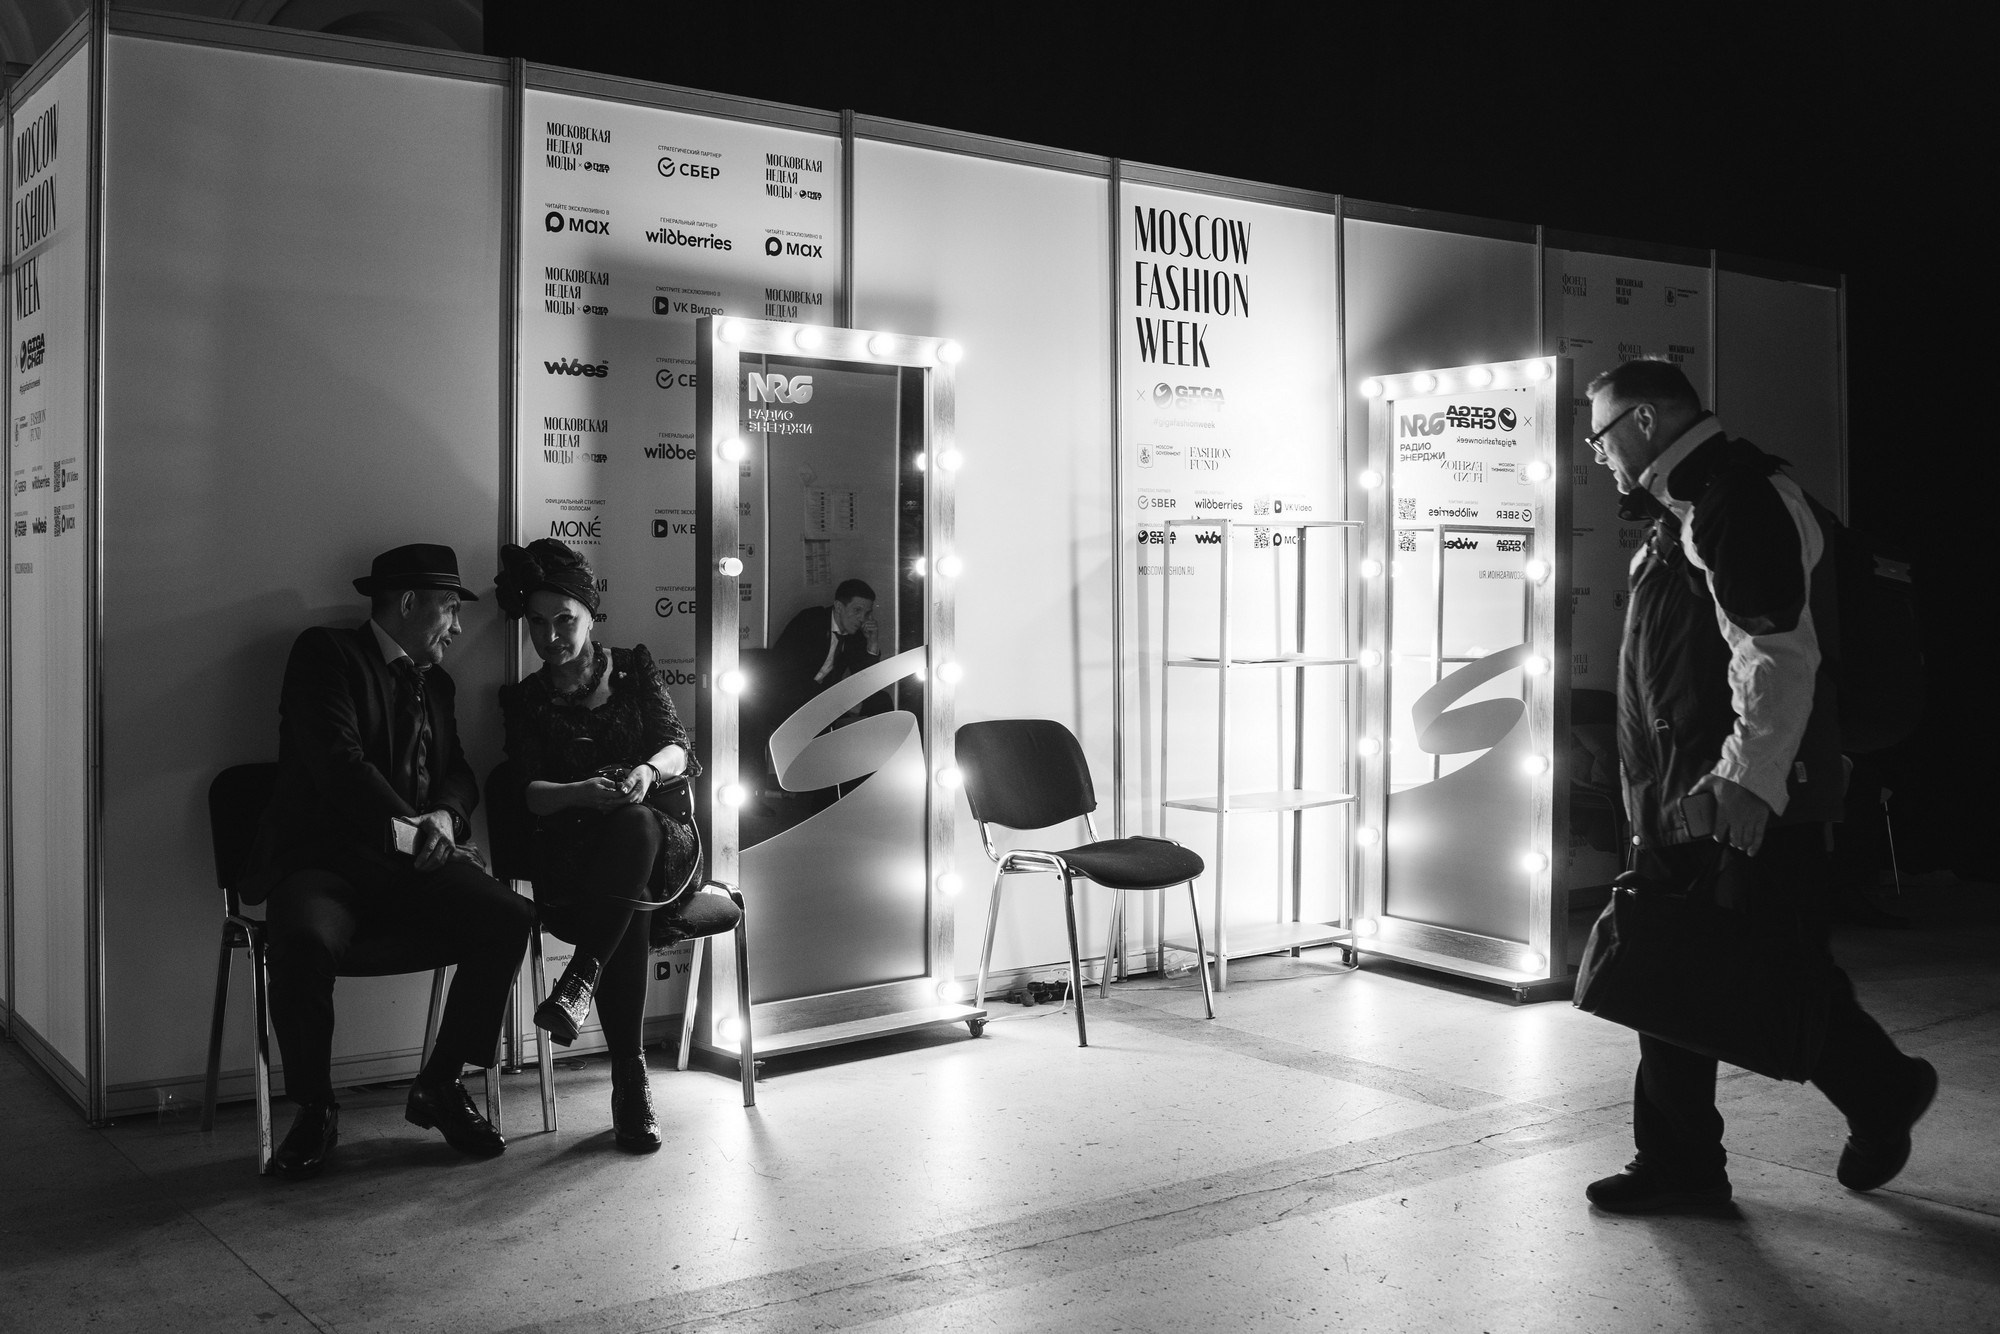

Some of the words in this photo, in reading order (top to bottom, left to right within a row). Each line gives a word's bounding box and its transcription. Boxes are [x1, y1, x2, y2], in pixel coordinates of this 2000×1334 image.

[547, 122, 610, 143] МОСКОВСКАЯ
[16, 99, 59, 190] MOSCOW
[547, 139, 582, 155] НЕДЕЛЯ
[658, 145, 699, 156] СТРАТЕГИЧЕСКИЙ
[546, 154, 576, 171] МОДЫ
[766, 153, 822, 172] МОСКОВСКАЯ
[680, 163, 720, 179] СБЕР
[766, 169, 798, 184] НЕДЕЛЯ
[766, 184, 792, 199] МОДЫ
[16, 172, 57, 256] FASHION
[568, 206, 605, 214] ЭКСКЛЮЗИВНО
[660, 217, 695, 226] ГЕНЕРАЛЬНЫЙ
[646, 228, 732, 251] wildberries
[1135, 205, 1250, 264] MOSCOW
[545, 267, 609, 286] МОСКОВСКАЯ
[16, 255, 41, 321] WEEK
[545, 283, 581, 299] НЕДЕЛЯ
[1136, 261, 1248, 318] FASHION
[765, 288, 822, 305] МОСКОВСКАЯ
[545, 300, 574, 315] МОДЫ
[673, 302, 688, 313] VK
[691, 303, 723, 316] Видео
[766, 304, 797, 318] НЕДЕЛЯ
[27, 333, 45, 354] GIGA
[1136, 316, 1209, 368] WEEK
[749, 372, 813, 404] NRG
[1175, 385, 1224, 400] GIGA
[749, 409, 794, 421] РАДИО
[544, 417, 608, 433] МОСКОВСКАЯ
[749, 422, 813, 435] ЭНЕРДЖИ
[1401, 412, 1445, 437] NRG
[544, 433, 580, 448] НЕДЕЛЯ
[659, 432, 694, 440] ГЕНЕРАЛЬНЫЙ
[644, 443, 696, 460] wildbe
[1190, 446, 1231, 458] FASHION
[1400, 442, 1431, 452] РАДИО
[544, 450, 573, 464] МОДЫ
[1190, 459, 1218, 470] FUND
[1400, 452, 1445, 462] ЭНЕРДЖИ
[1151, 498, 1176, 508] SBER
[1195, 499, 1242, 510] wildberries
[1294, 504, 1312, 512] Video
[551, 516, 601, 537] MONÉ
[673, 524, 688, 534] VK
[1138, 566, 1194, 575] MOSCOWSHION.RU
[675, 962, 689, 974] VK
